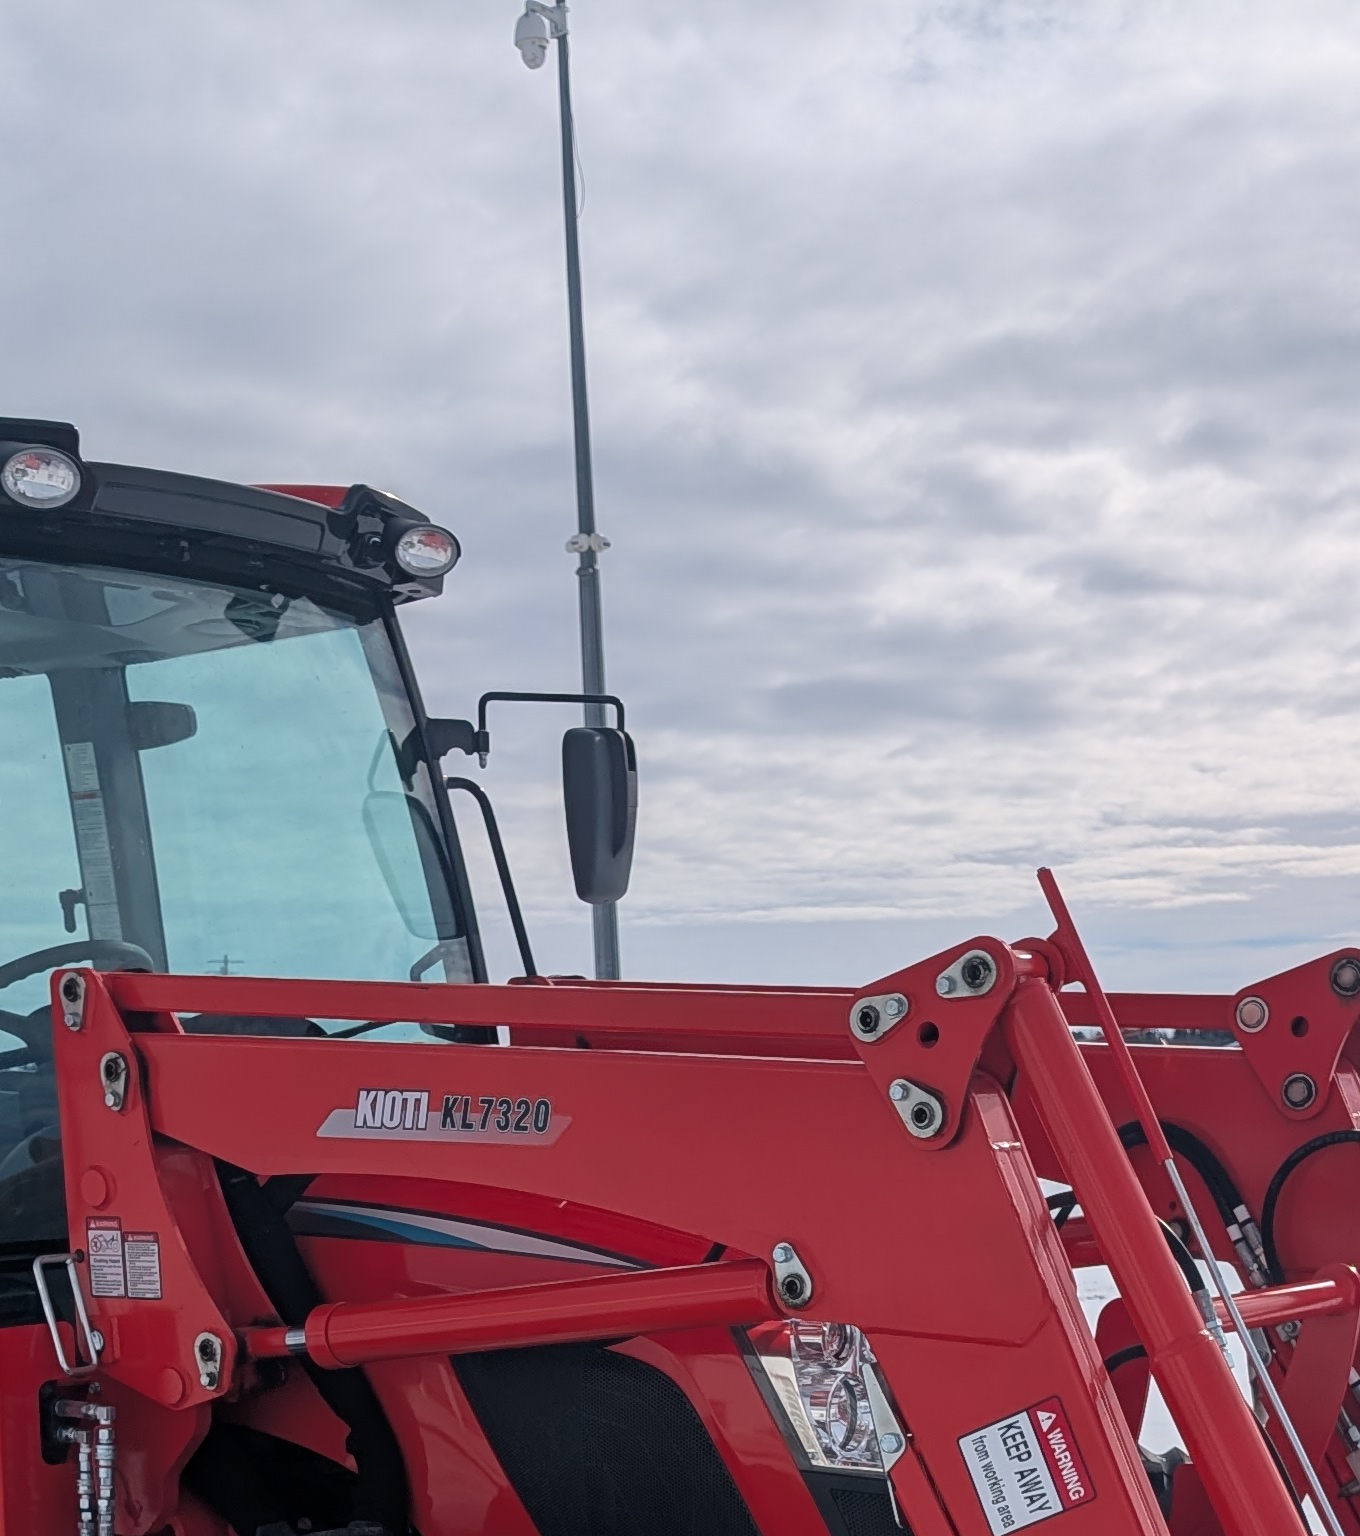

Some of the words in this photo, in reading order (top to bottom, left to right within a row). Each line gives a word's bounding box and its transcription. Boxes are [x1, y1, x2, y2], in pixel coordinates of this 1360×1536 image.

[354, 1088, 431, 1131] KIOTI
[440, 1095, 552, 1134] KL7320
[997, 1420, 1032, 1463] KEEP
[1047, 1427, 1085, 1501] WARNING
[971, 1434, 990, 1462] from
[981, 1461, 1007, 1505] working
[997, 1504, 1016, 1529] area
[1014, 1467, 1053, 1514] AWAY
